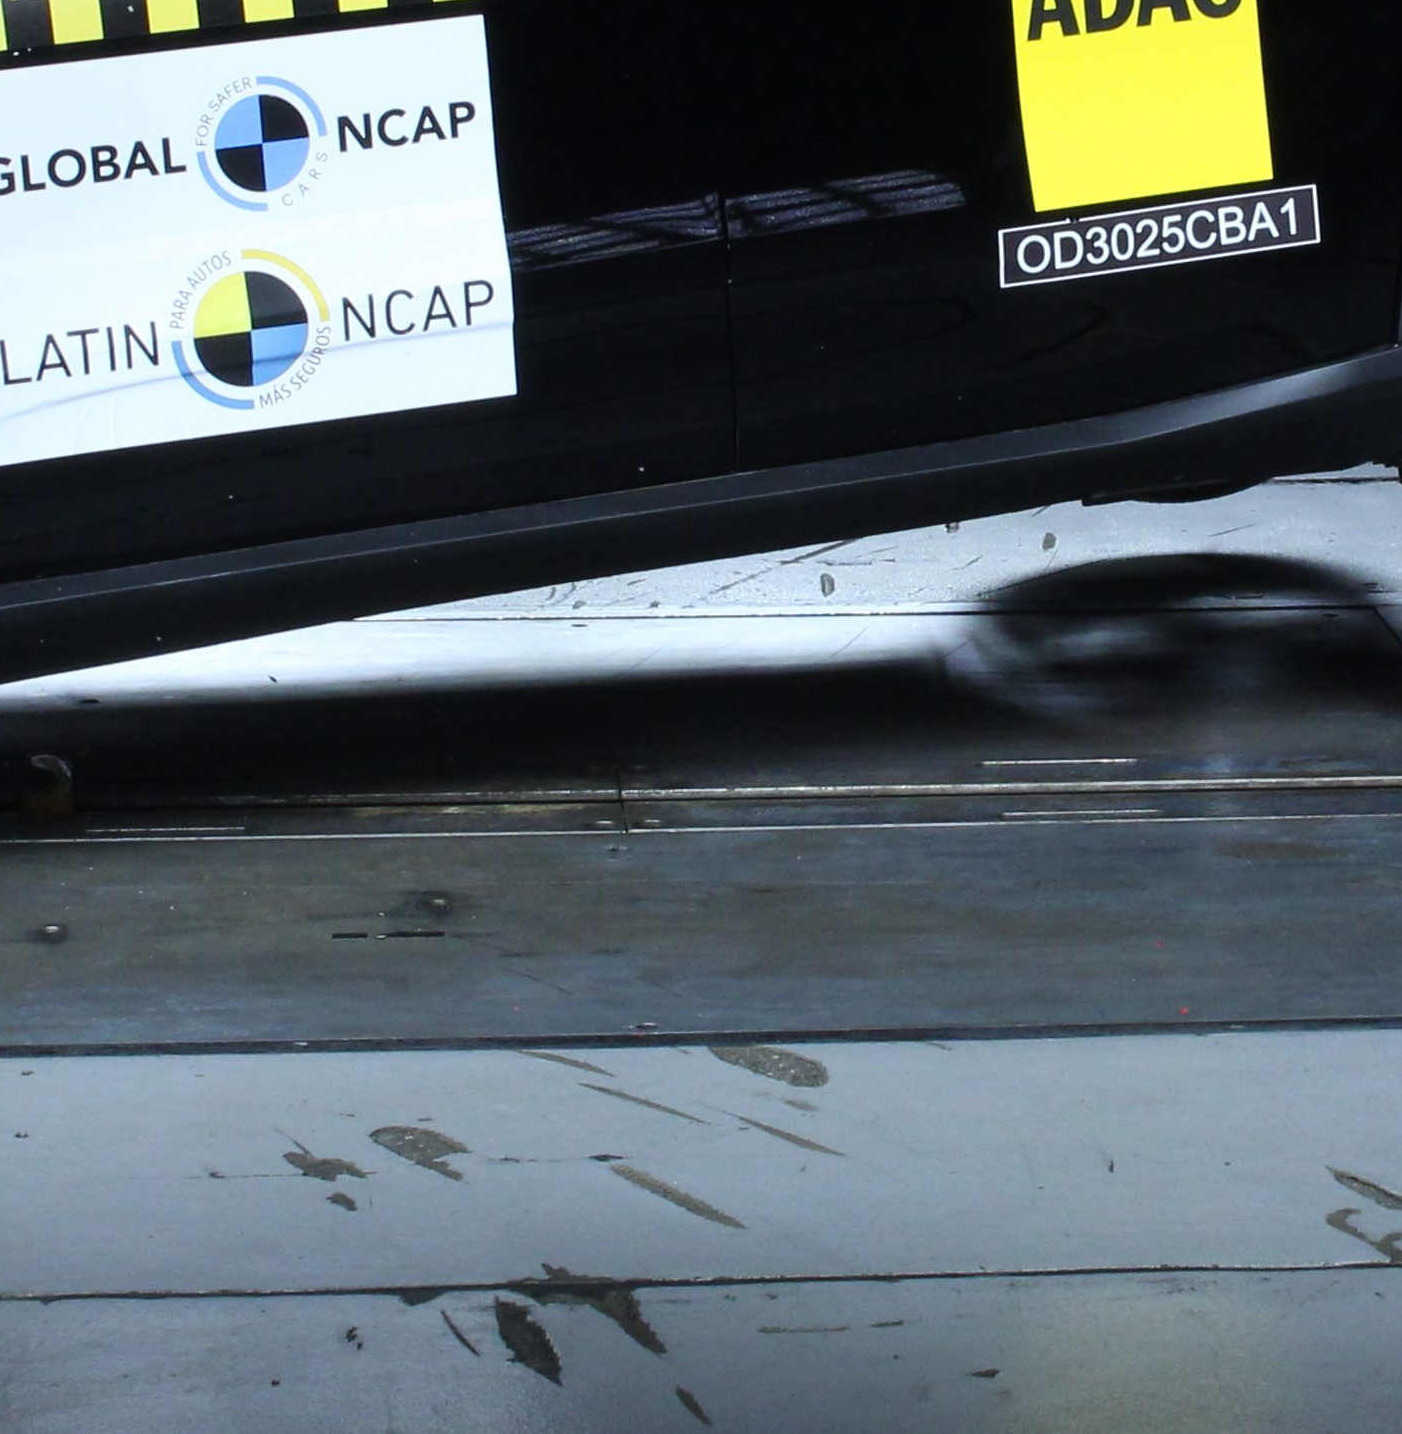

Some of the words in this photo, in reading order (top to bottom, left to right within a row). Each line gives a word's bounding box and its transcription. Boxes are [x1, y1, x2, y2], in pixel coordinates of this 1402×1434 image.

[195, 113, 214, 147] FOR
[207, 76, 253, 113] SAFER
[336, 101, 477, 153] NCAP
[281, 150, 329, 207] CARS
[1015, 196, 1299, 274] OD3025CBA1
[169, 289, 193, 330] PARA
[186, 250, 233, 291] AUTOS
[0, 320, 161, 387] LATIN
[341, 279, 494, 342] NCAP
[258, 383, 293, 409] MÁS
[289, 325, 332, 392] SEGUROS
